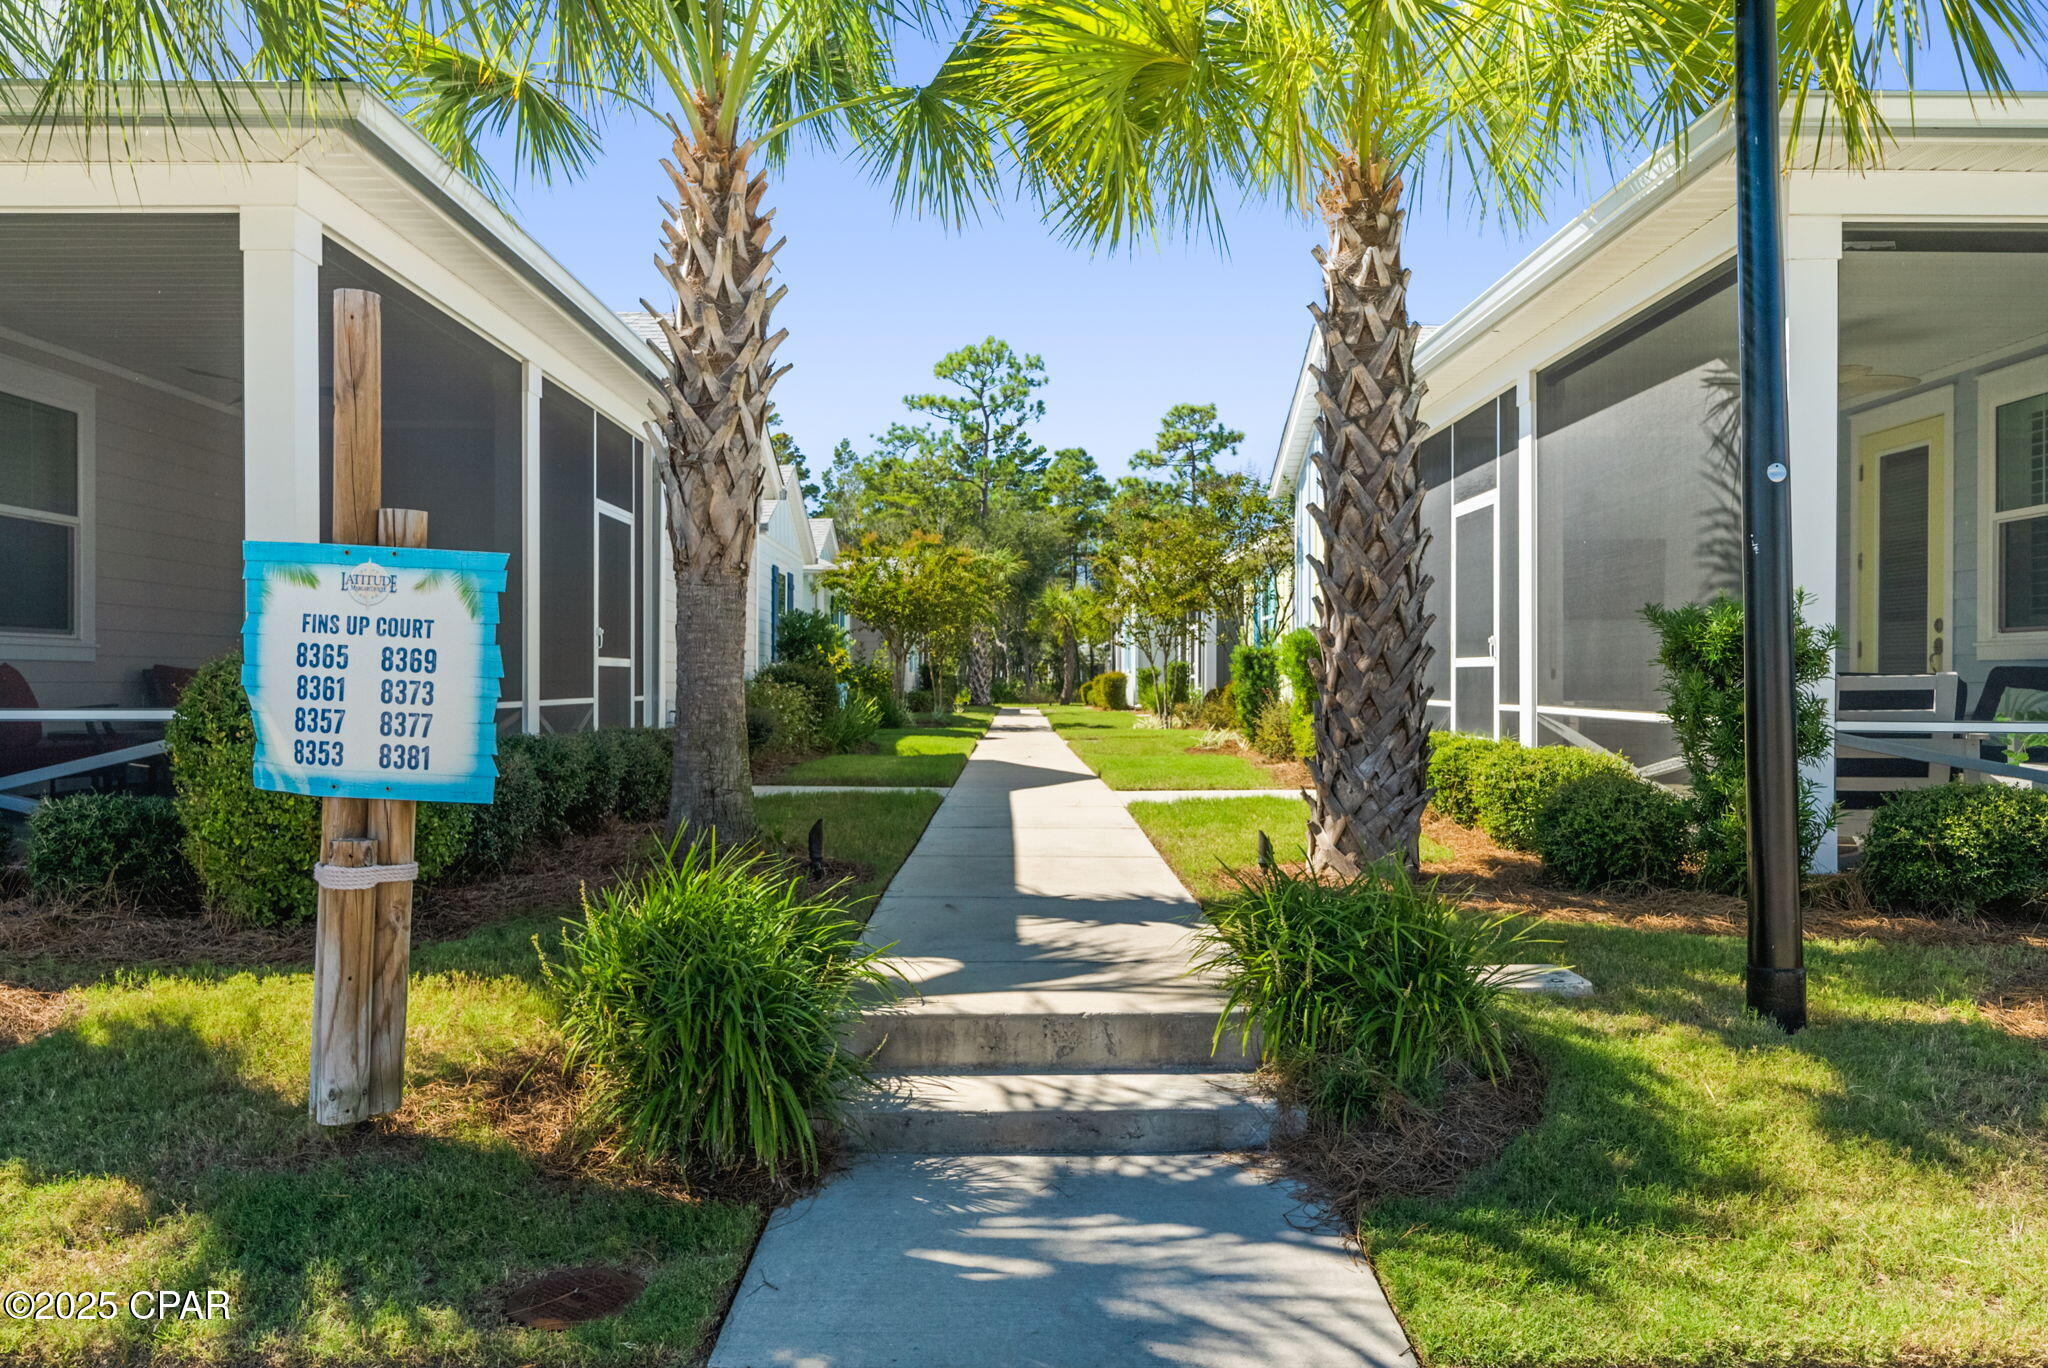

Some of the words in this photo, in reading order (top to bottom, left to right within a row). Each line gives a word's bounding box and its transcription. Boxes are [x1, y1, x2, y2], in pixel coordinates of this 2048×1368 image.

[341, 572, 398, 593] LATITUDE
[302, 613, 340, 634] FINS
[346, 616, 370, 635] UP
[376, 617, 434, 638] COURT
[296, 643, 348, 669] 8365
[381, 647, 437, 673] 8369
[297, 675, 345, 701] 8361
[380, 679, 434, 706] 8373
[295, 707, 345, 734] 8357
[380, 712, 433, 738] 8377
[294, 740, 343, 766] 8353
[379, 744, 430, 770] 8381
